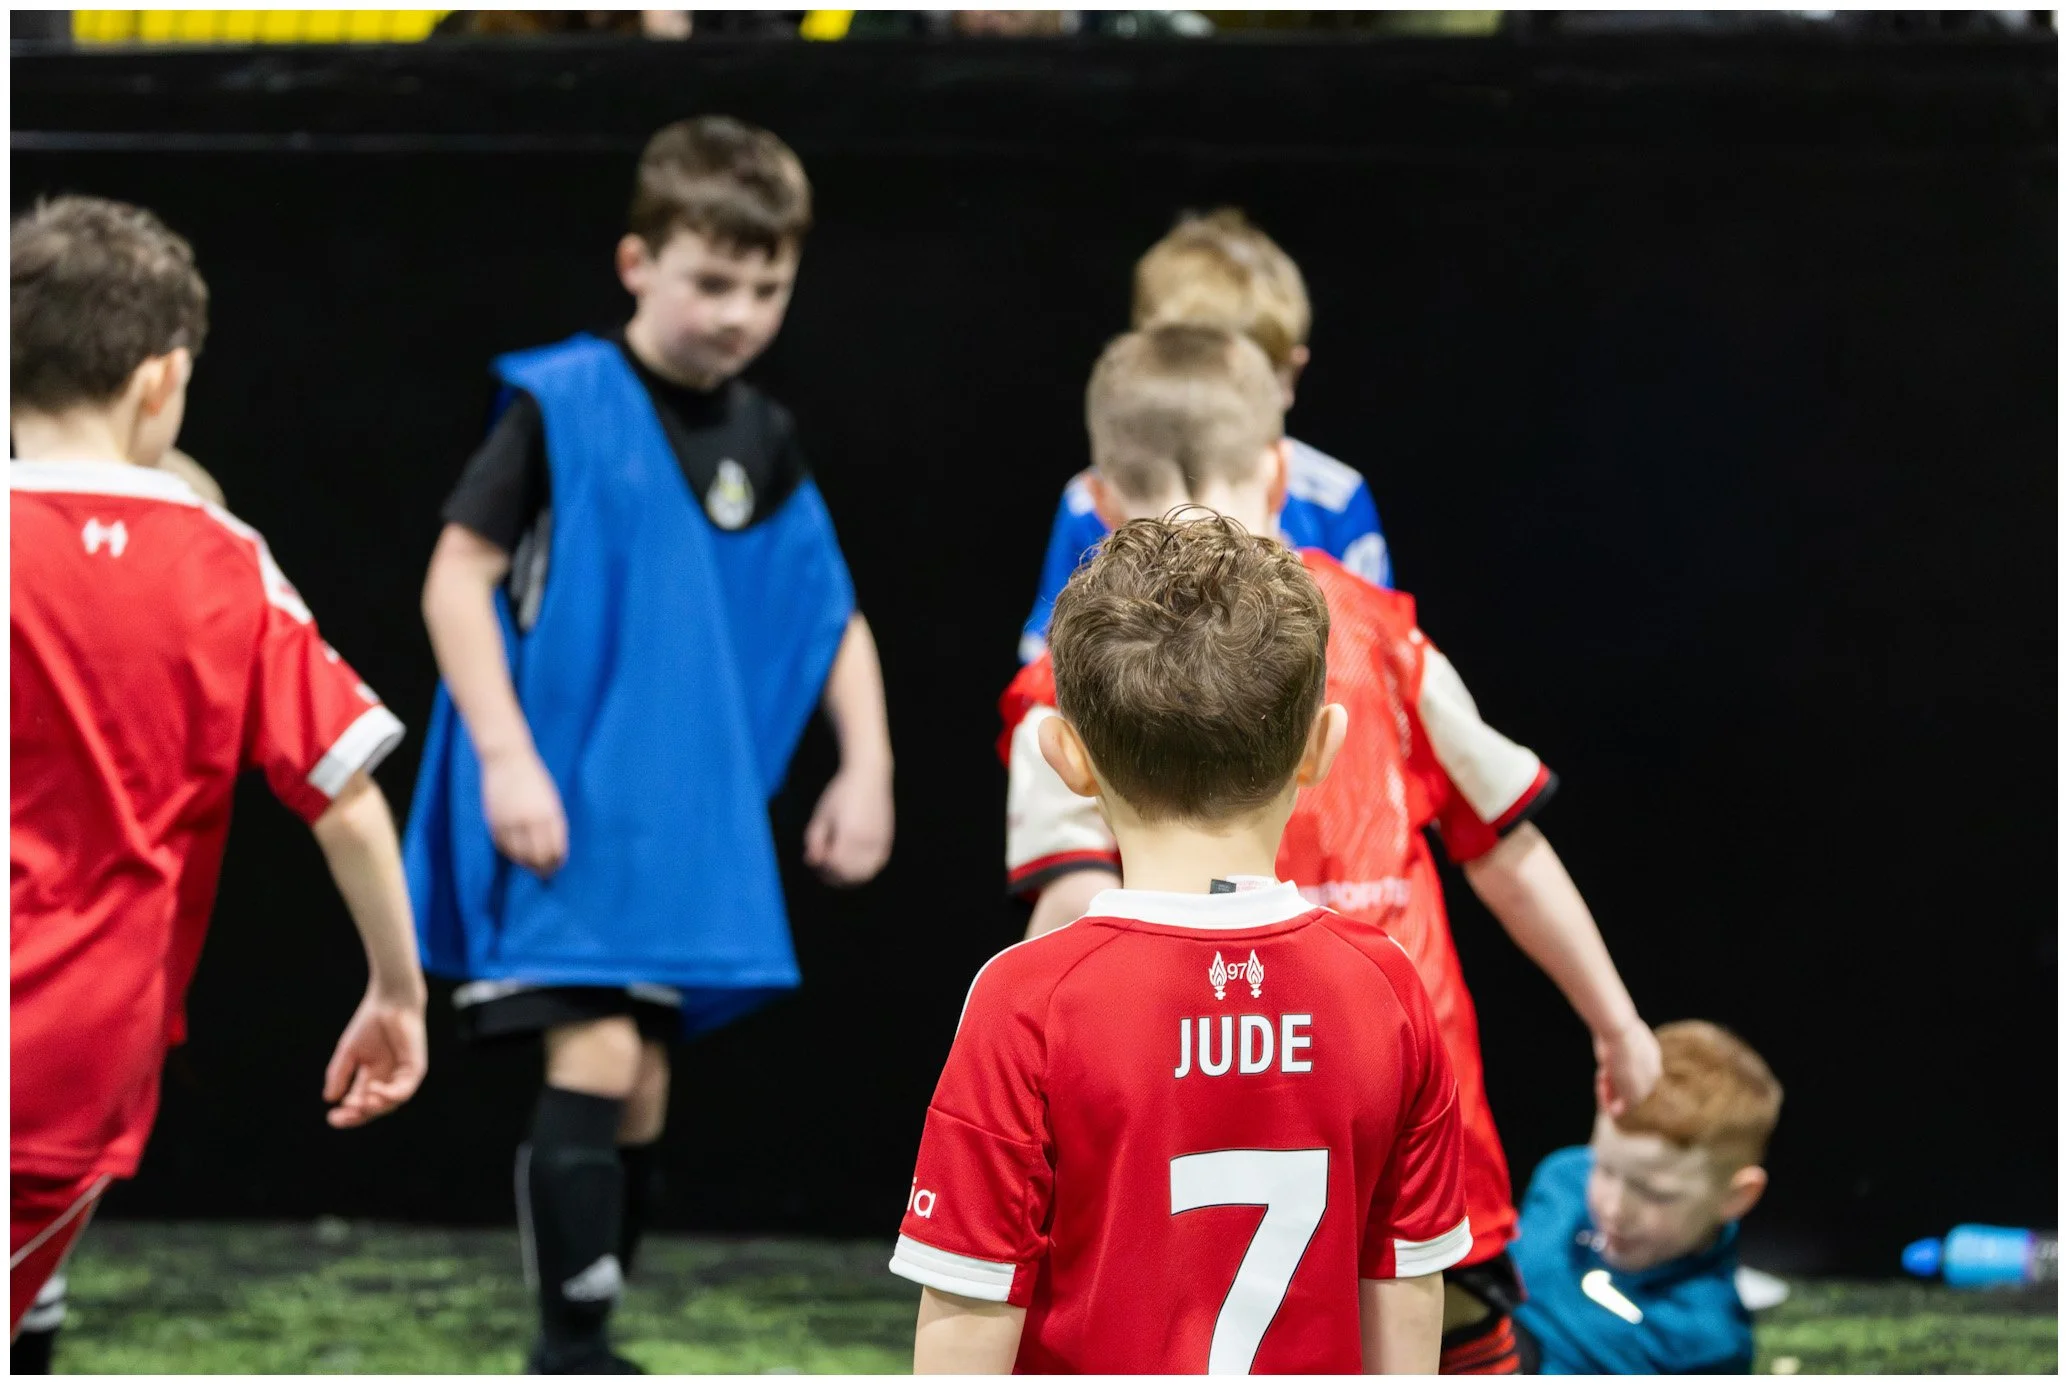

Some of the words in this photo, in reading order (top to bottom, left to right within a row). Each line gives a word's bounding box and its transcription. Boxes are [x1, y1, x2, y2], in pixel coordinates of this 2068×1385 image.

[1226, 962, 1248, 981] 97
[1174, 1014, 1313, 1079] JUDE
[1169, 1148, 1330, 1375] 7
